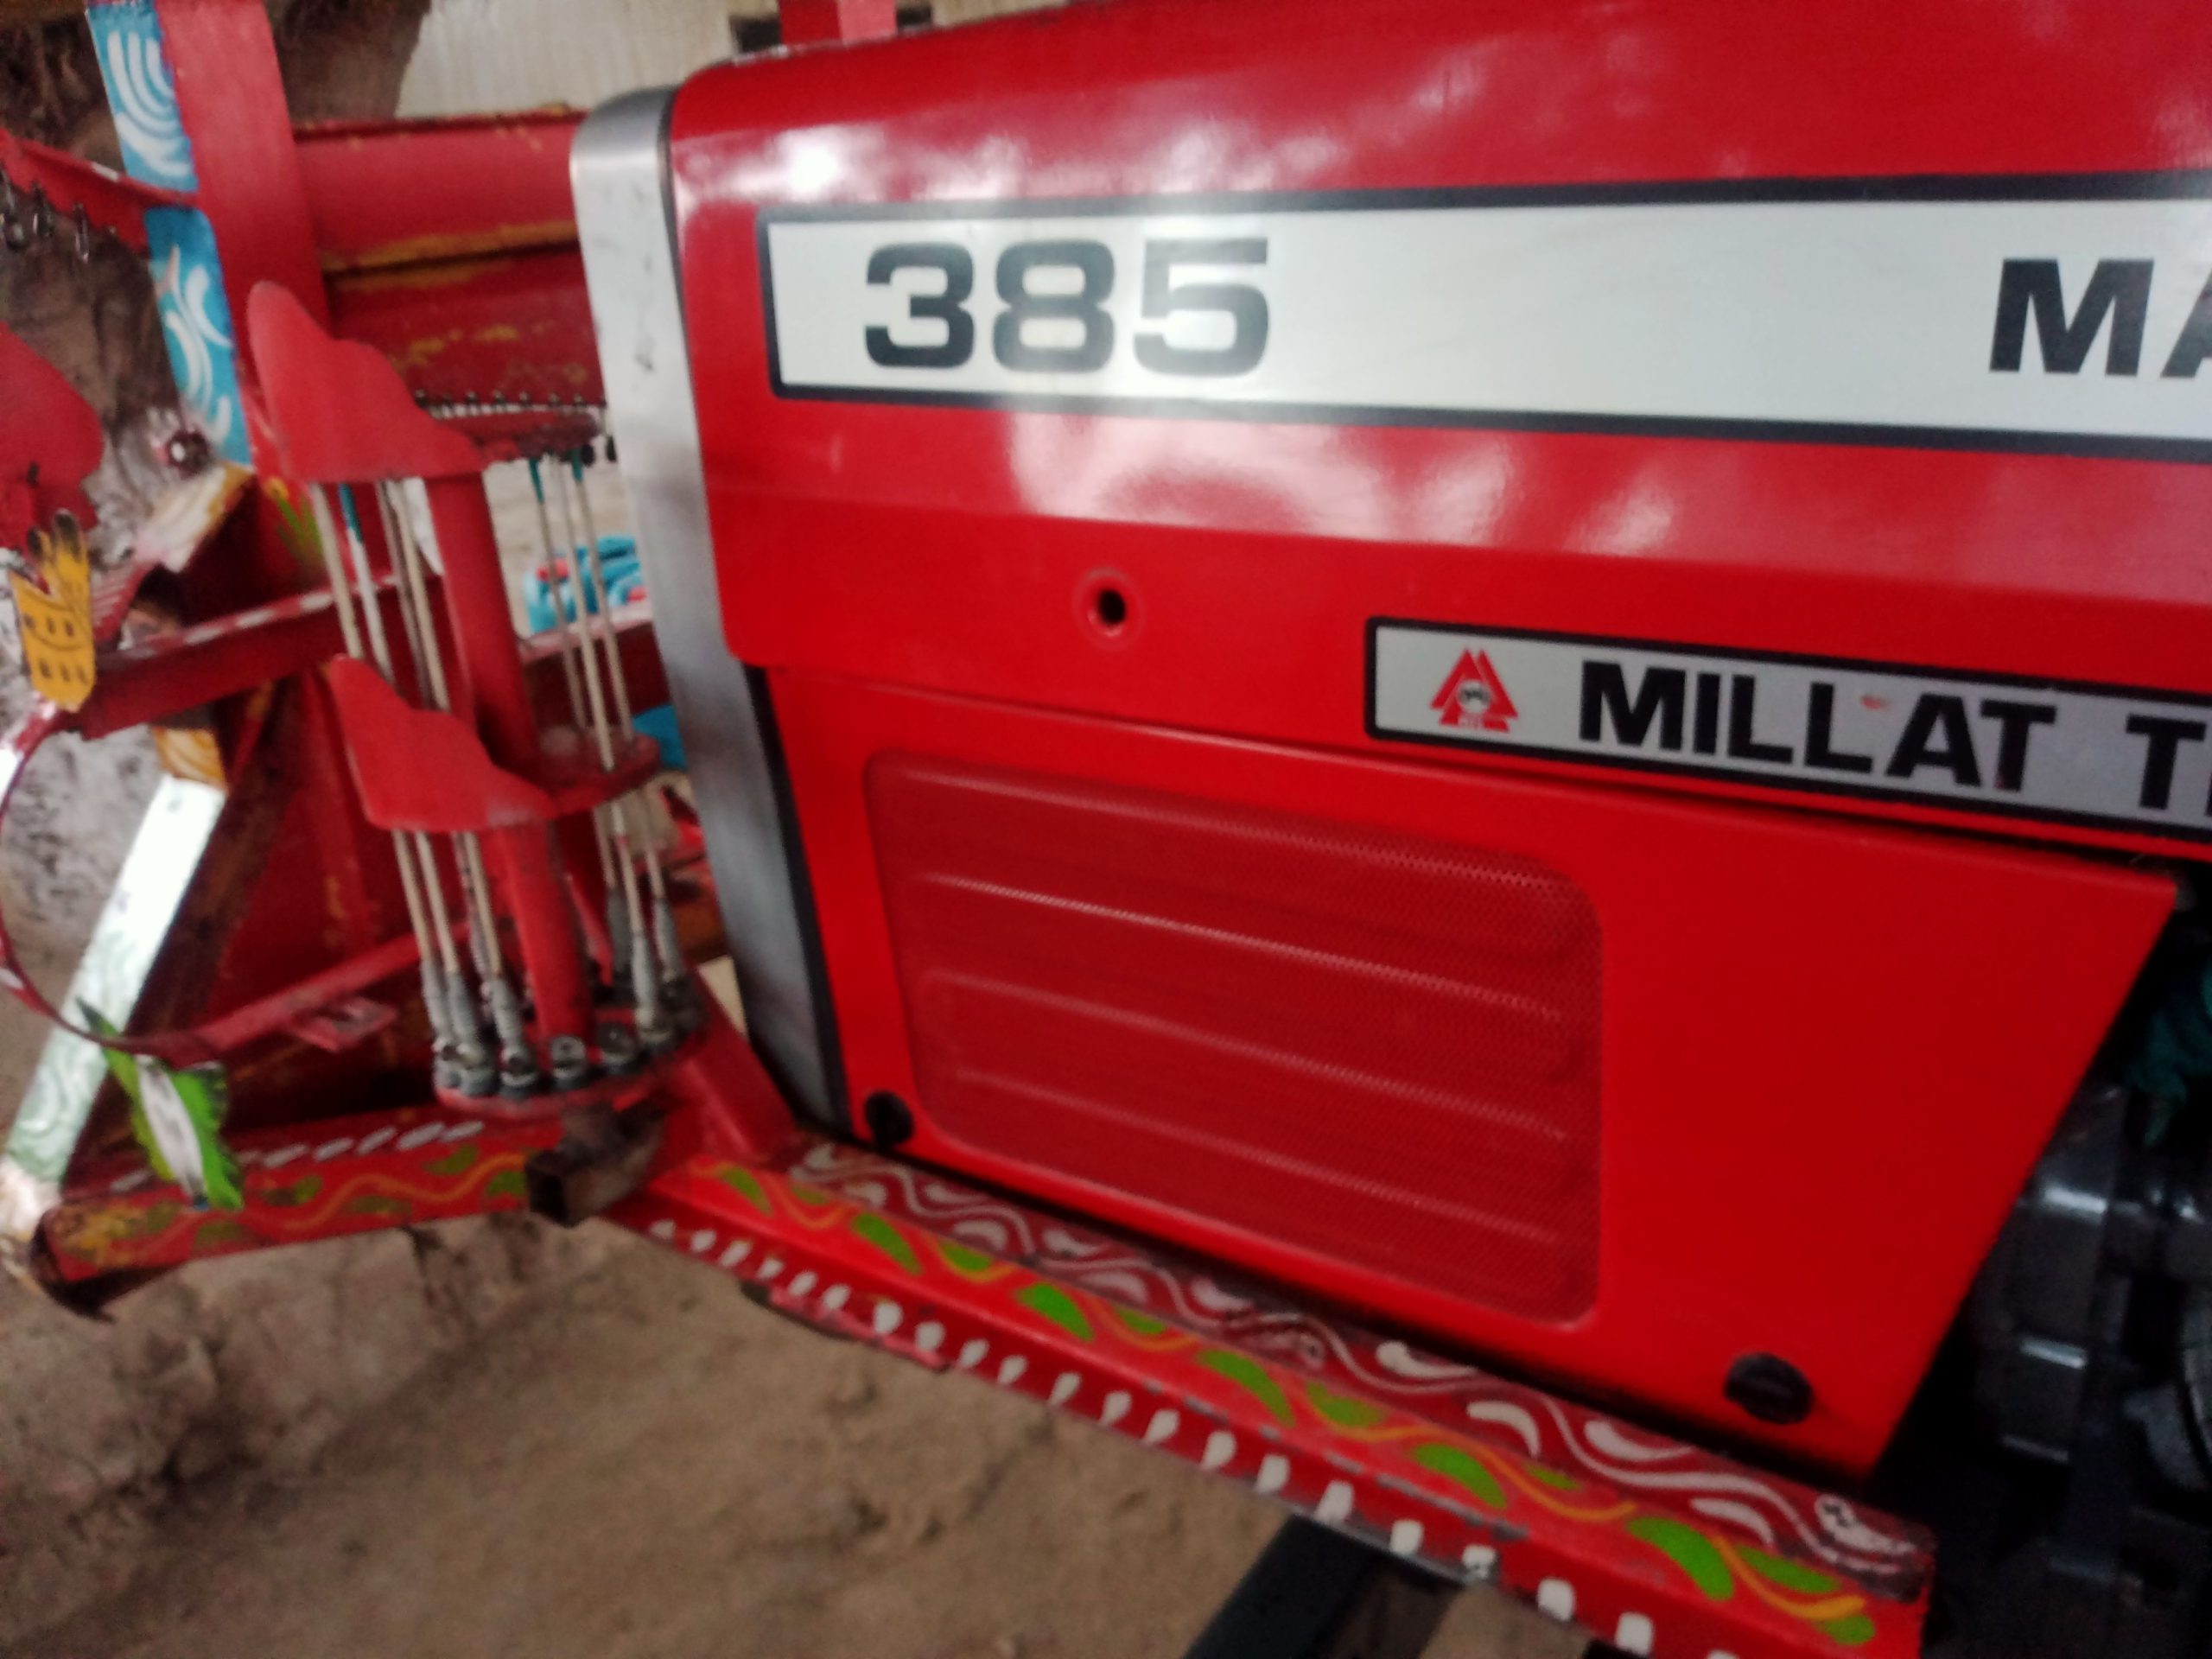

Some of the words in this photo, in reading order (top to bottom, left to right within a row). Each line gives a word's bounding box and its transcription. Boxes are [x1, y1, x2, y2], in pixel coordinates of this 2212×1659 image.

[865, 238, 1269, 378] 385
[1579, 660, 2057, 792] MILLAT
[2126, 713, 2212, 817] T
